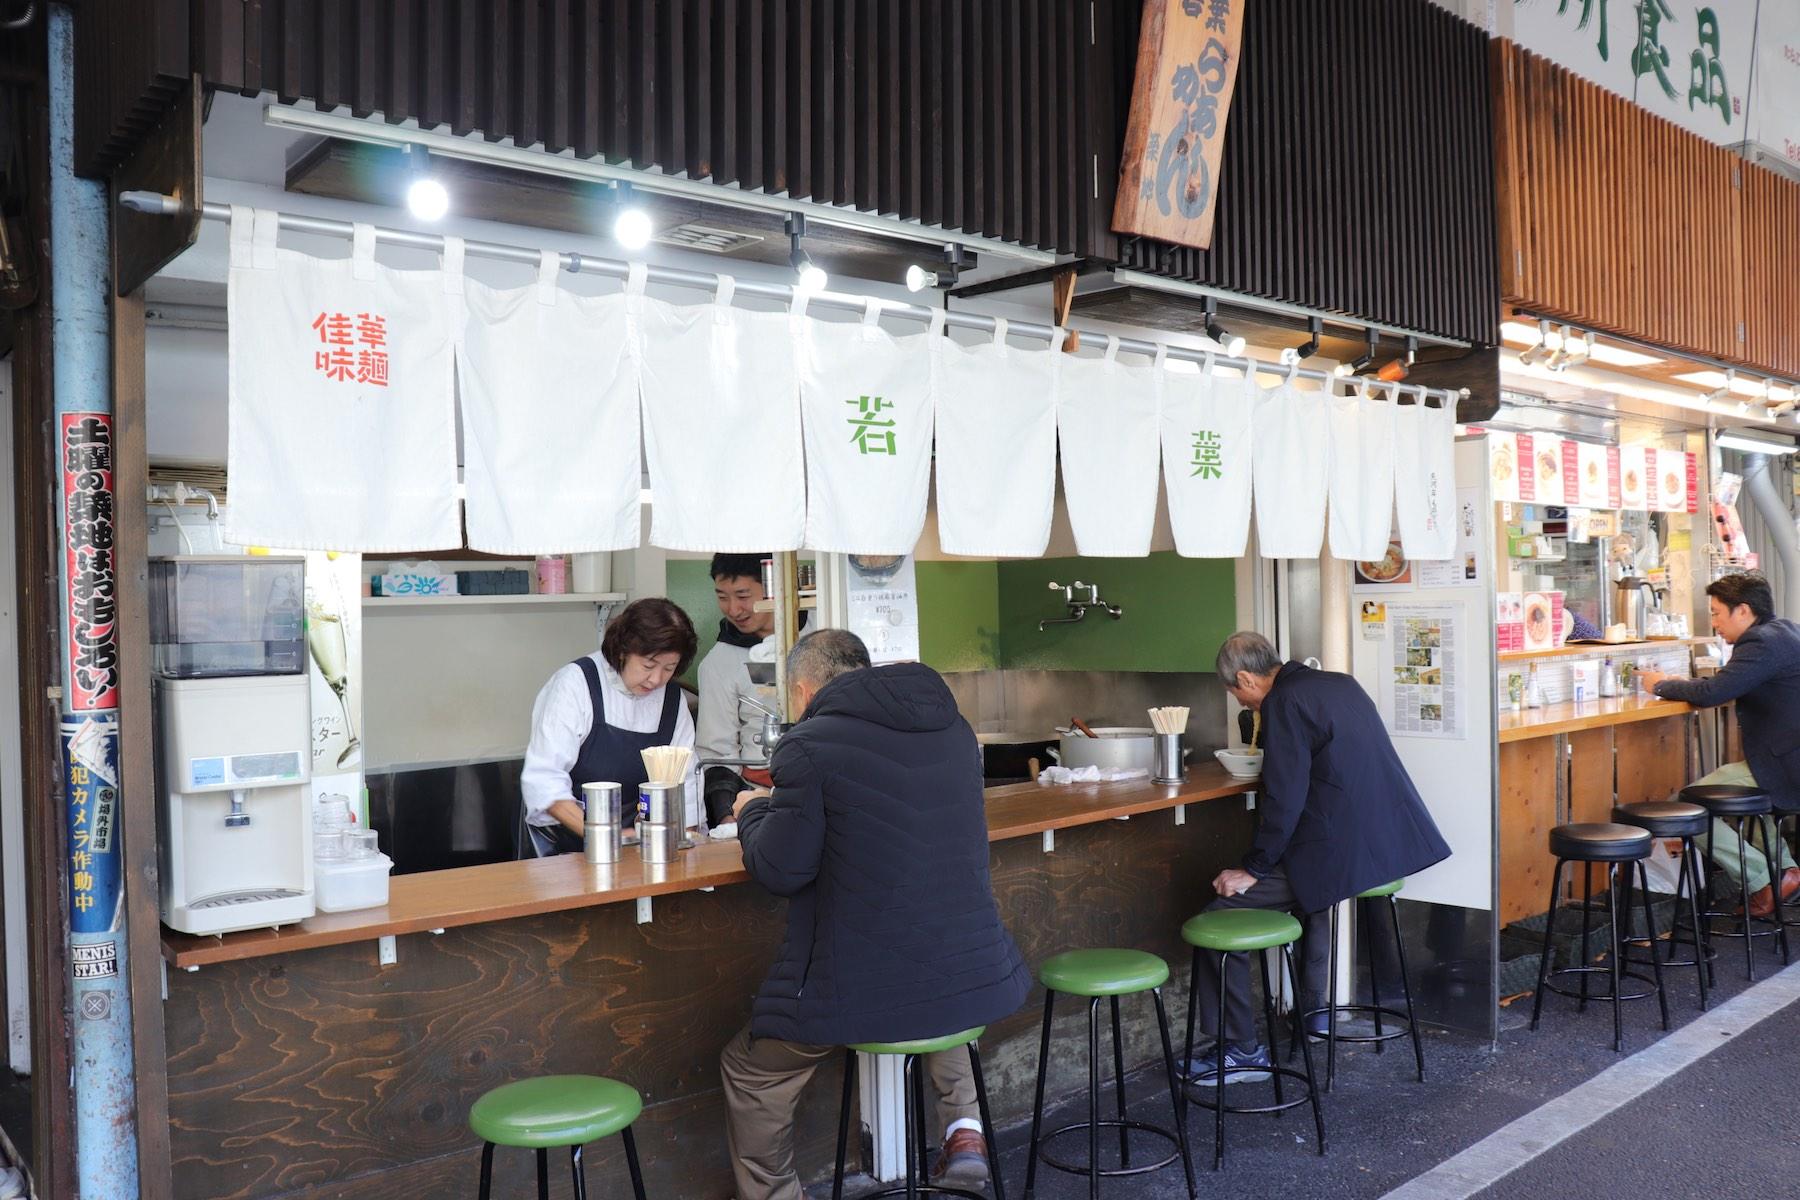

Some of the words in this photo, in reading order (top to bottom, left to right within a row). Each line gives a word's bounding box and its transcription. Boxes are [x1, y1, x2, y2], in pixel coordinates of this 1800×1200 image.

[845, 396, 896, 456] 若
[1190, 430, 1222, 480] 葉
[312, 727, 341, 742] ター
[71, 751, 94, 913] 犯カメラ作動中
[72, 945, 116, 961] MENIS
[74, 961, 114, 977] STAR!
